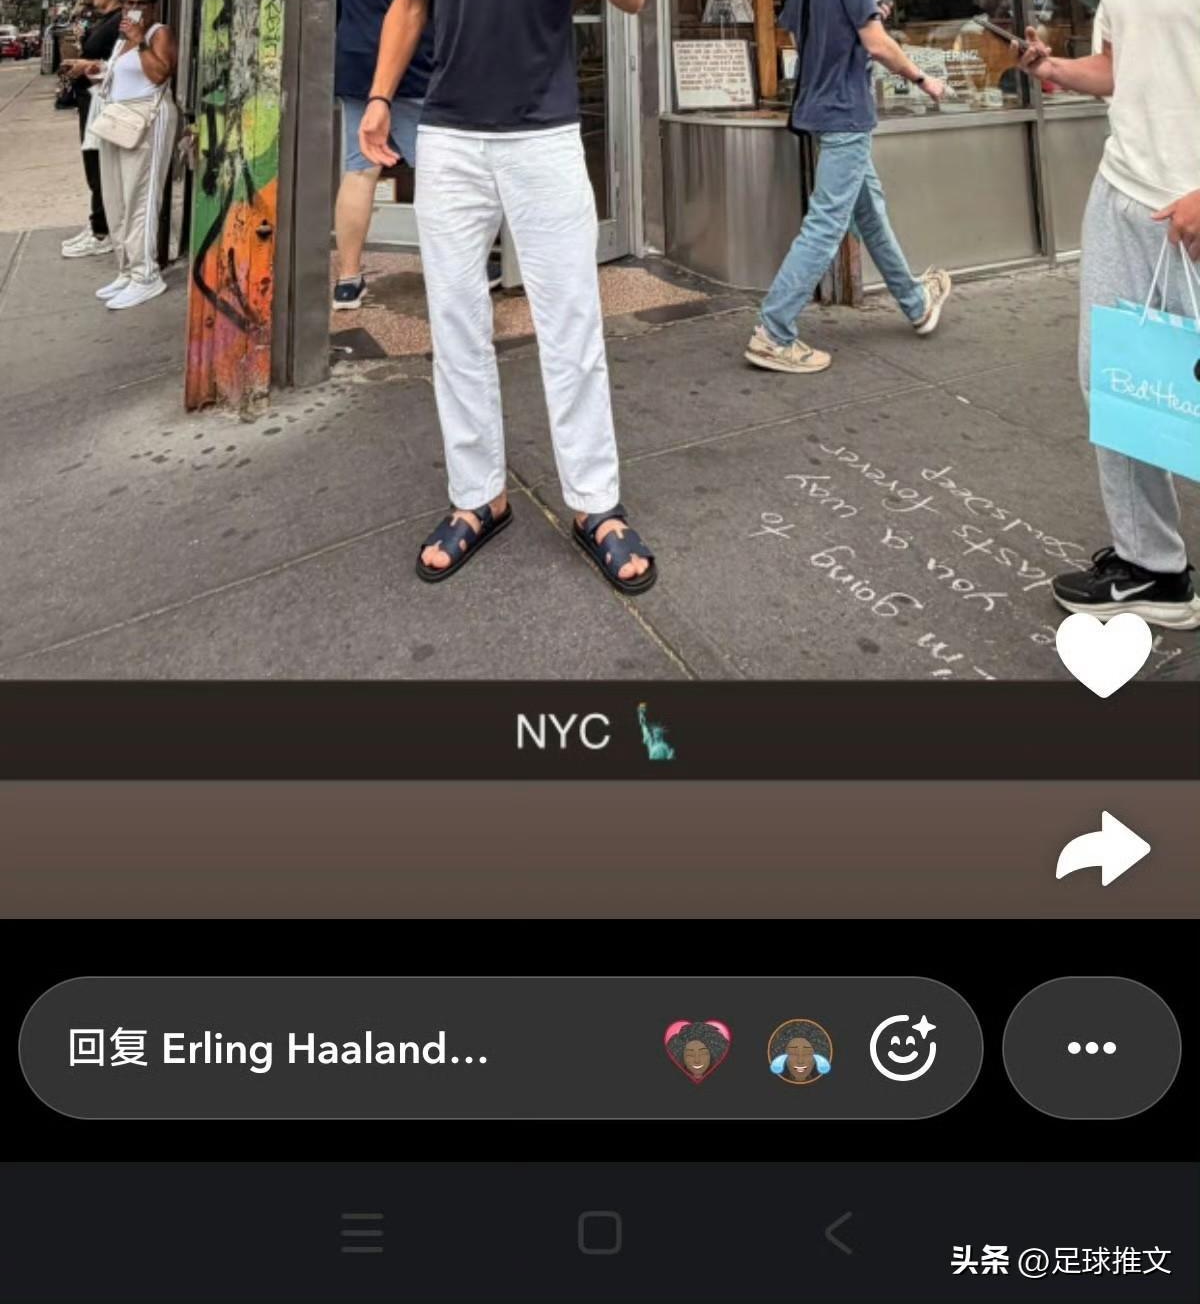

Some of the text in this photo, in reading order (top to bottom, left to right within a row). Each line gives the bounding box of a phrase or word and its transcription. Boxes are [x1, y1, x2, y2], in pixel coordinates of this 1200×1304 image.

[783, 474, 858, 518] way
[818, 444, 1056, 592] lasts forever
[748, 511, 796, 539] to
[880, 527, 910, 550] a
[810, 546, 924, 617] going
[926, 558, 1008, 611] you
